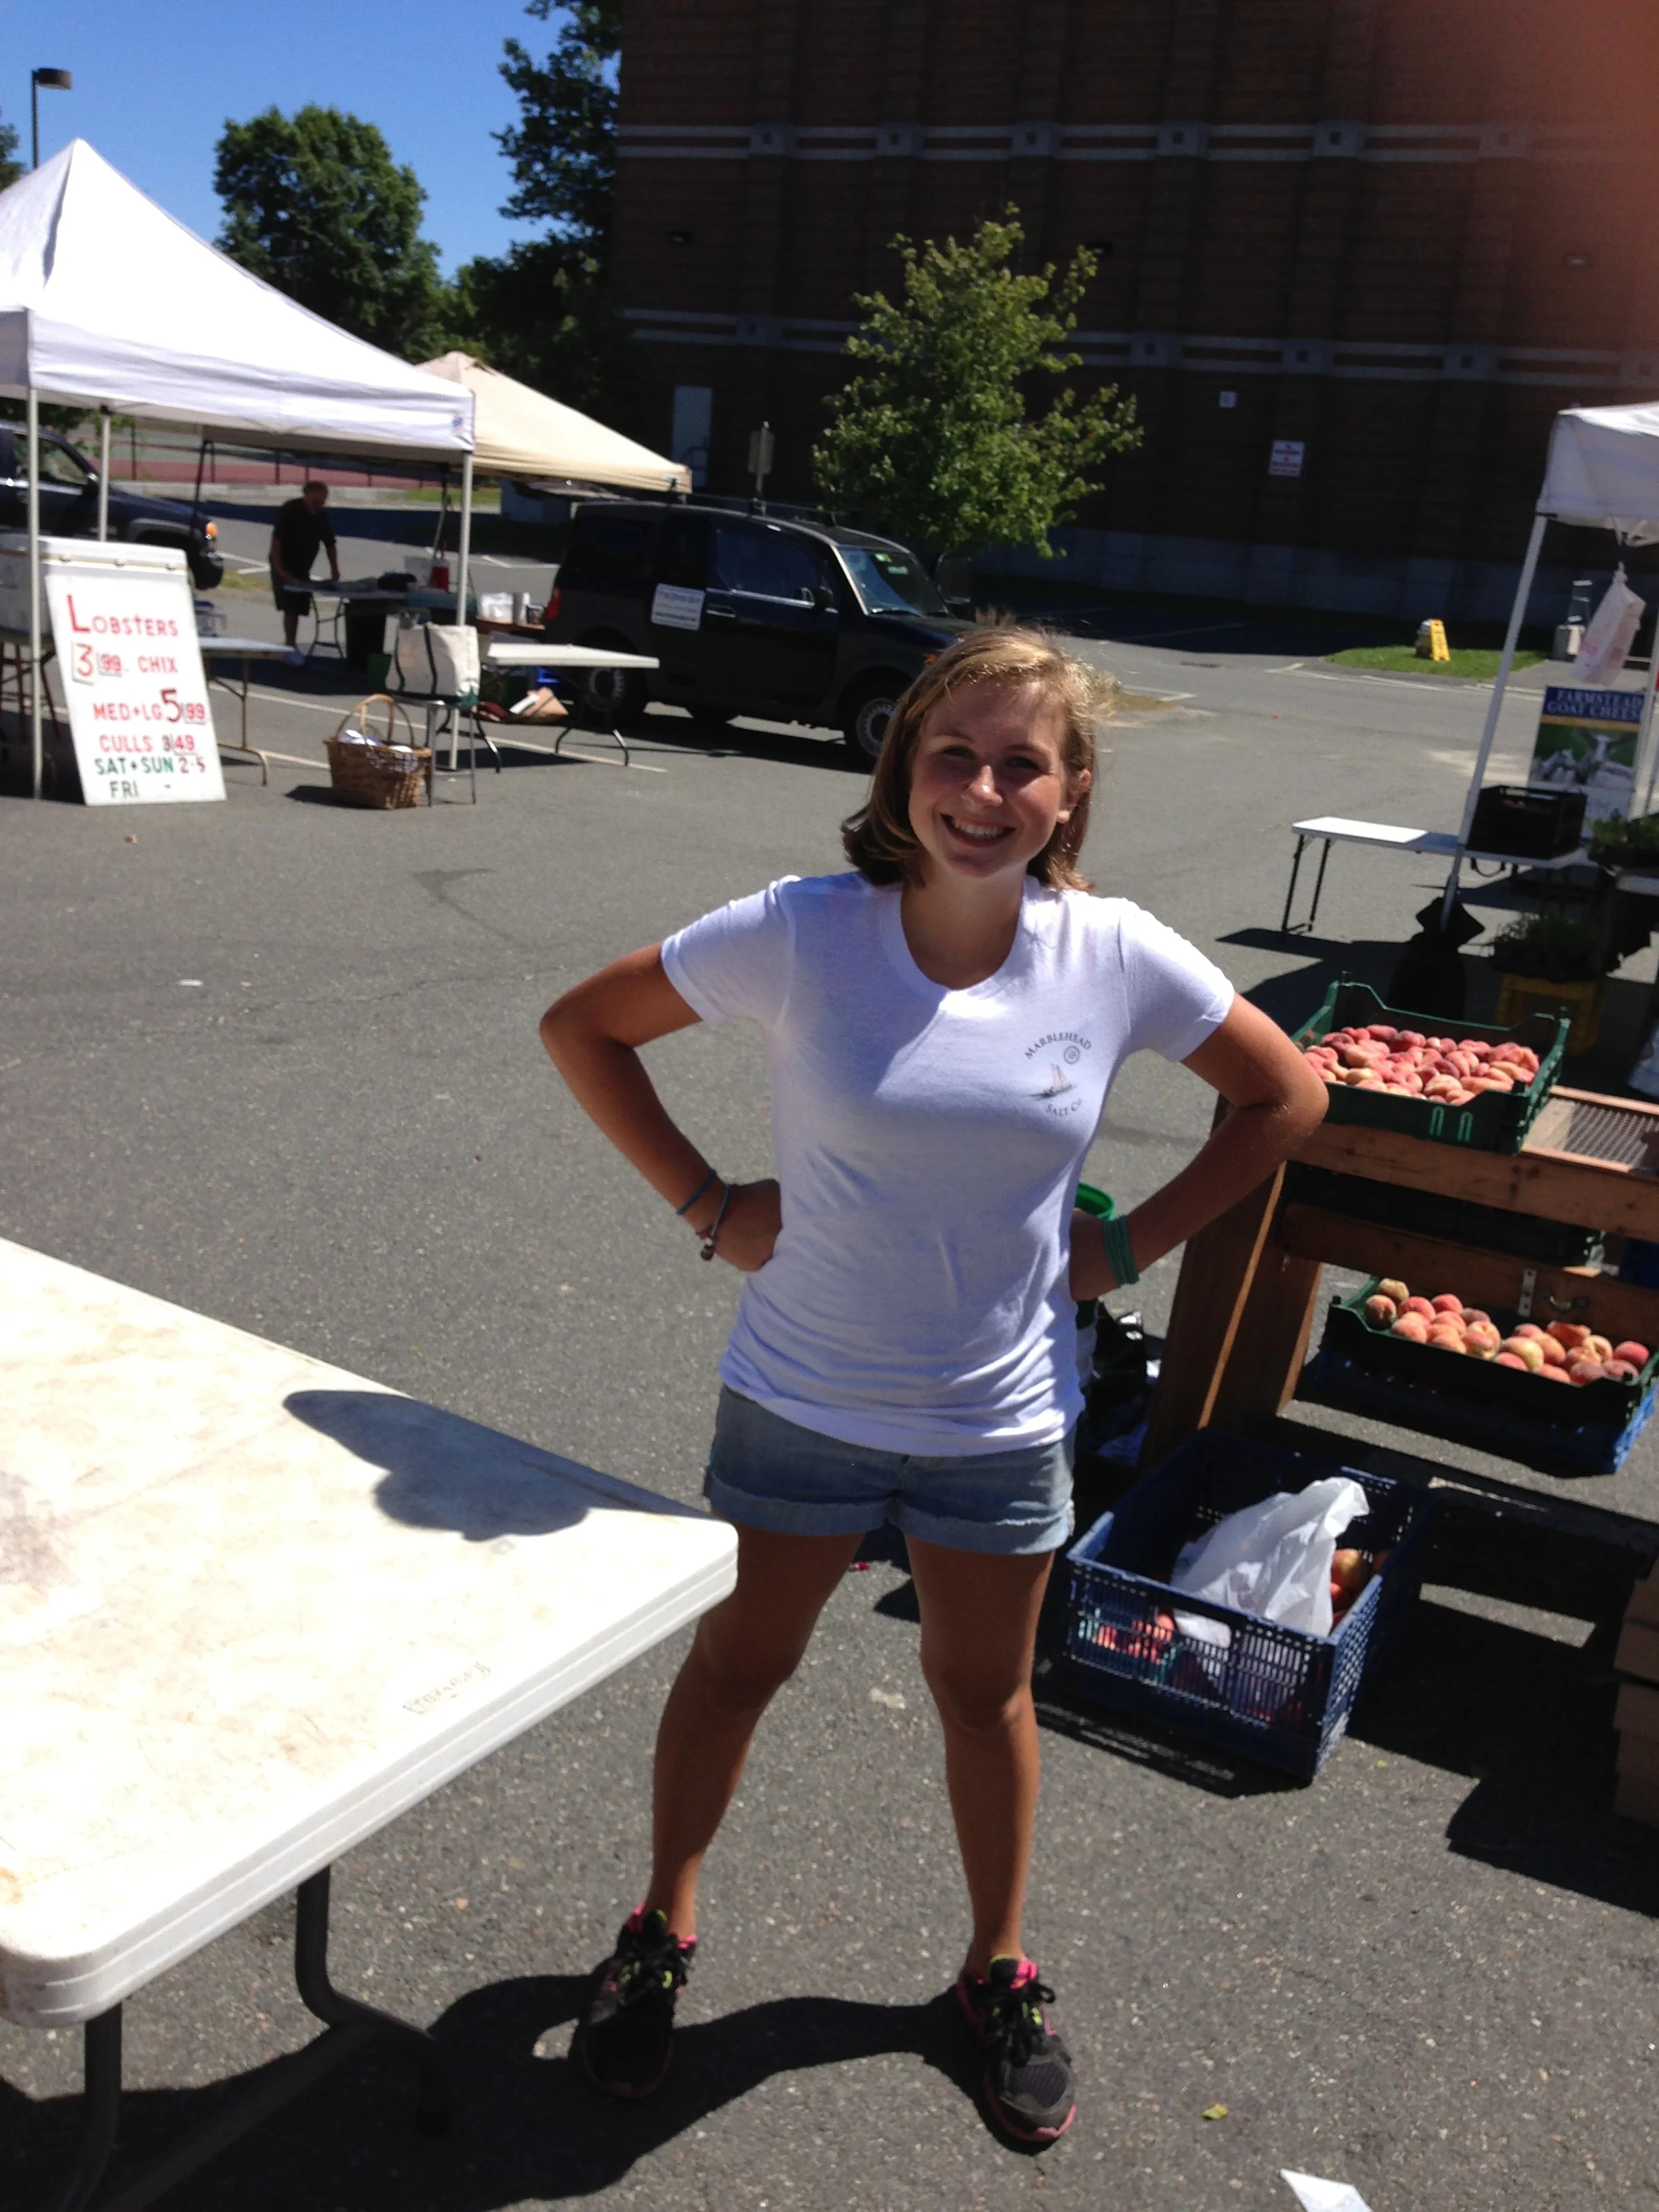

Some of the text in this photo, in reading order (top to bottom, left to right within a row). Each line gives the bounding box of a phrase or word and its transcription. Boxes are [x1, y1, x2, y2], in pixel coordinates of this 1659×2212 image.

[67, 594, 178, 636] LOBSTERS
[138, 655, 178, 673] CHIX
[1589, 705, 1639, 720] CHEES
[99, 735, 152, 752] CULLS
[110, 781, 139, 798] FRI
[1024, 1032, 1092, 1059] MARBLEHEAD
